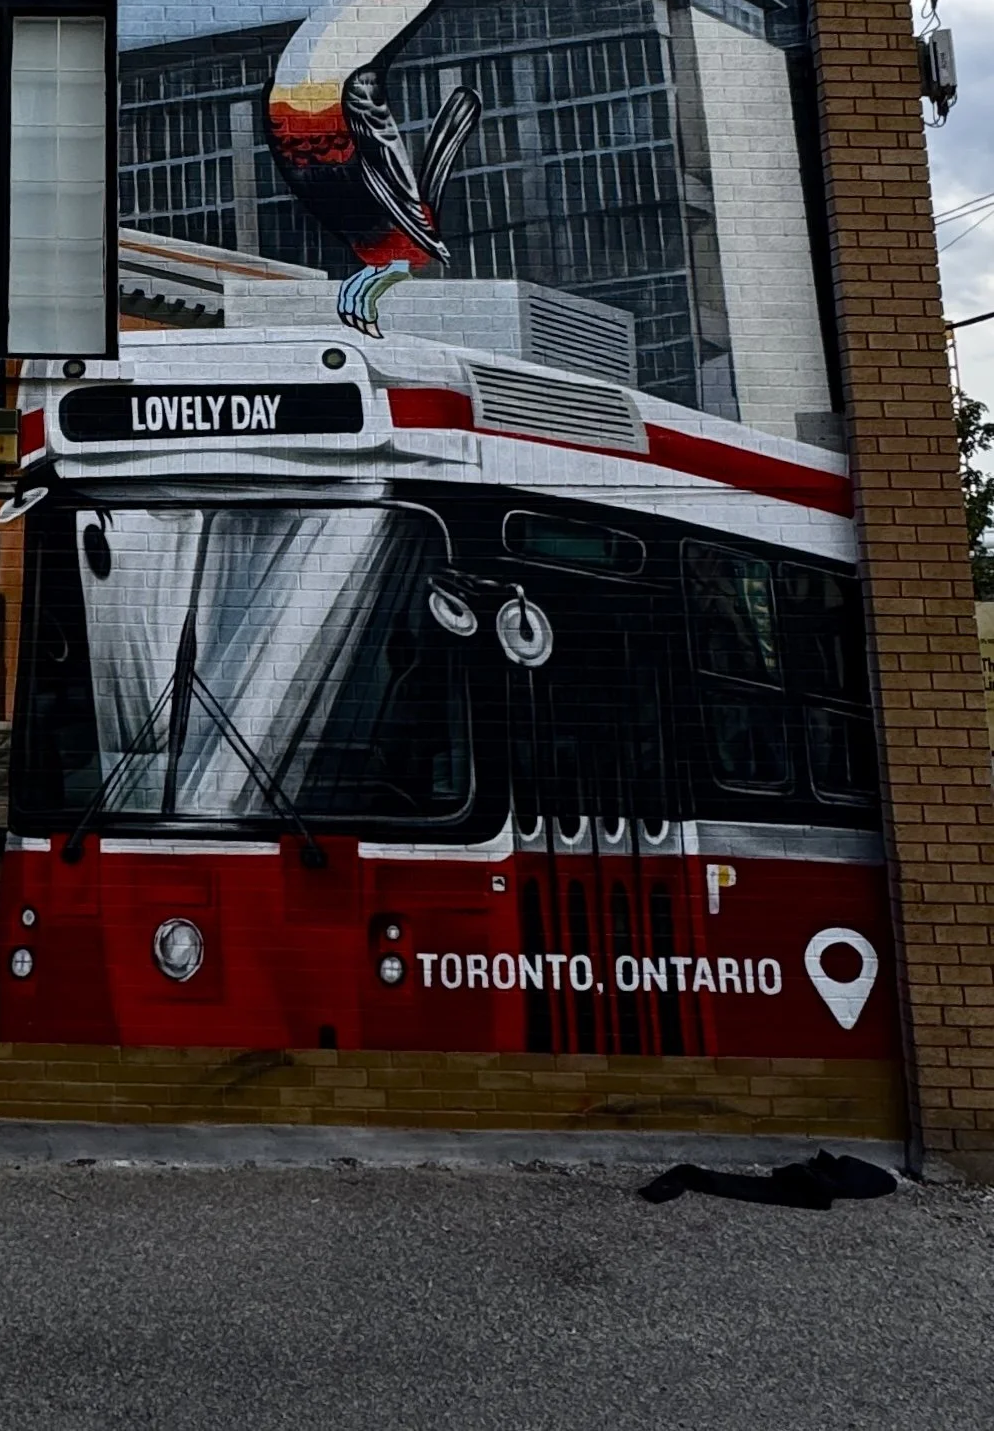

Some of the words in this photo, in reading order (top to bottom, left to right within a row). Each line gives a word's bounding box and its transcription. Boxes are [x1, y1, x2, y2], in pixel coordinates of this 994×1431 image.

[131, 395, 225, 432] LOVELY
[231, 394, 281, 430] DAY
[416, 953, 605, 995] TORONTO,
[615, 955, 782, 995] ONTARIO
